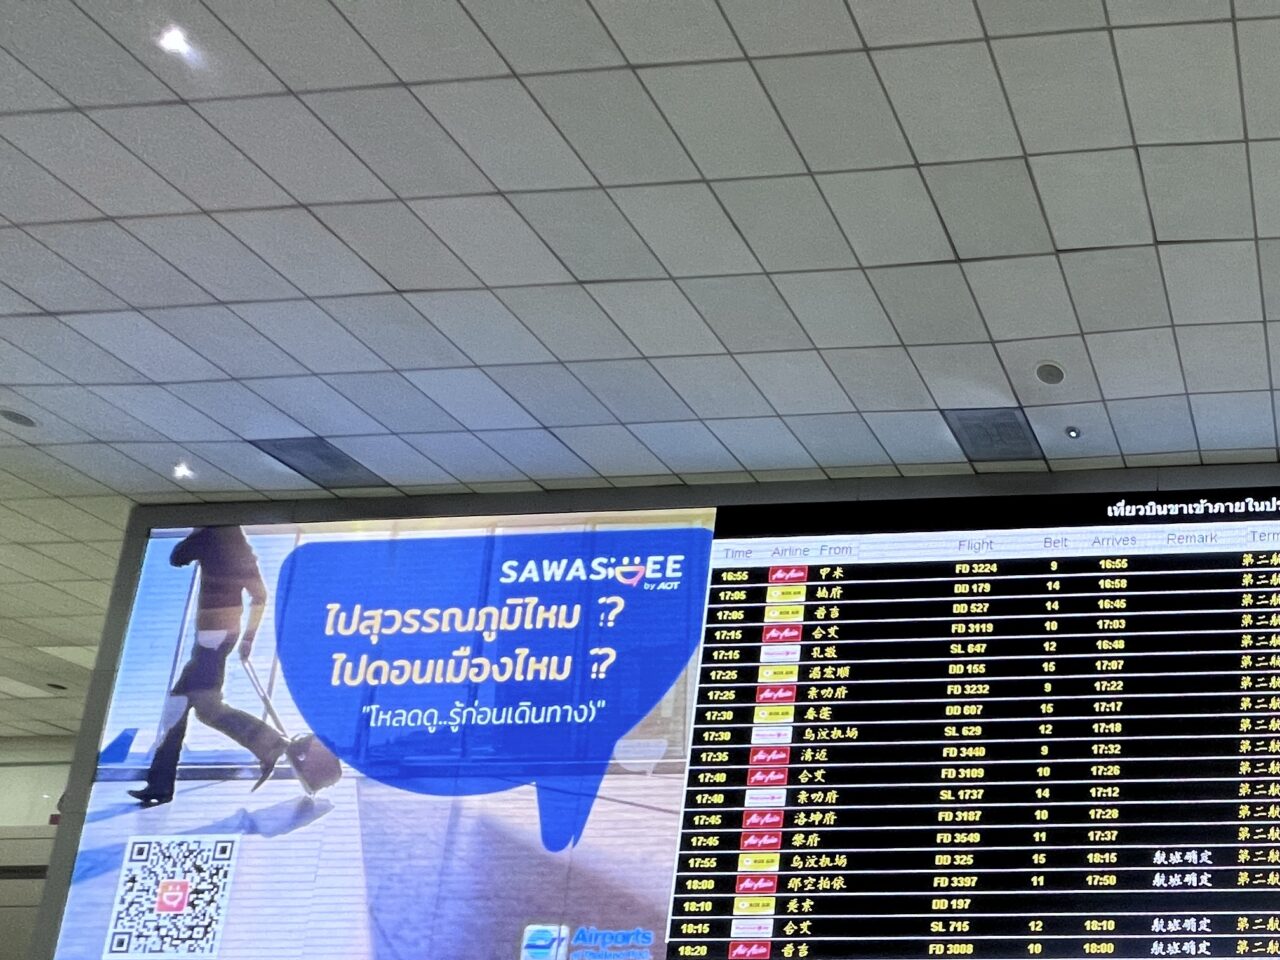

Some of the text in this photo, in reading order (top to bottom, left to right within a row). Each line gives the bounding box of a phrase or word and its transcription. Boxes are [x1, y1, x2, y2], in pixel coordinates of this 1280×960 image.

[724, 547, 753, 560] Time
[819, 544, 853, 557] From
[958, 538, 994, 553] Flight
[1043, 536, 1068, 549] Belt
[1092, 534, 1137, 547] Arrives
[1167, 532, 1218, 545] Remark
[955, 562, 998, 574] FD 3224
[1099, 558, 1128, 569] 16:55
[721, 570, 749, 581] 16:55
[643, 582, 656, 591] by
[953, 582, 991, 594] DD 179
[718, 590, 747, 601] 17:05
[952, 602, 990, 614] DD 527
[324, 597, 582, 645] ไปสุวรรณภูมิไหม
[716, 610, 745, 621] 17:05
[951, 622, 994, 634] FD 3119
[1096, 618, 1126, 630] 17:03
[714, 629, 743, 640] 17:15
[712, 649, 741, 660] 17:15
[330, 645, 573, 687] ไปดอนเมืองไหม
[948, 663, 986, 675] DD 155
[709, 670, 738, 681] 17:25
[946, 684, 990, 695] FD 3232
[1093, 680, 1124, 692] 17:22
[707, 690, 736, 701] 17:25
[1093, 701, 1123, 712] 17:17
[704, 710, 734, 721] 17:30
[702, 731, 732, 742] 17:30
[1091, 743, 1122, 755] 17:32
[700, 751, 729, 762] 17:35
[1090, 765, 1121, 776] 17:26
[697, 772, 727, 783] 17:40
[939, 788, 985, 800] SL 1737
[1089, 786, 1120, 798] 17:12
[695, 793, 725, 804] 17:40
[693, 814, 722, 826] 17:45
[690, 836, 720, 847] 17:45
[1087, 830, 1119, 842] 17:37
[688, 857, 718, 868] 17:55
[934, 854, 974, 866] DD 325
[1086, 852, 1118, 864] 18:15
[685, 879, 715, 890] 18:00
[683, 901, 713, 912] 18:10
[931, 898, 972, 910] DD 197
[680, 923, 710, 934] 18:15
[930, 920, 970, 933] SL 715
[571, 927, 653, 947] Airports
[678, 945, 708, 956] 18:20
